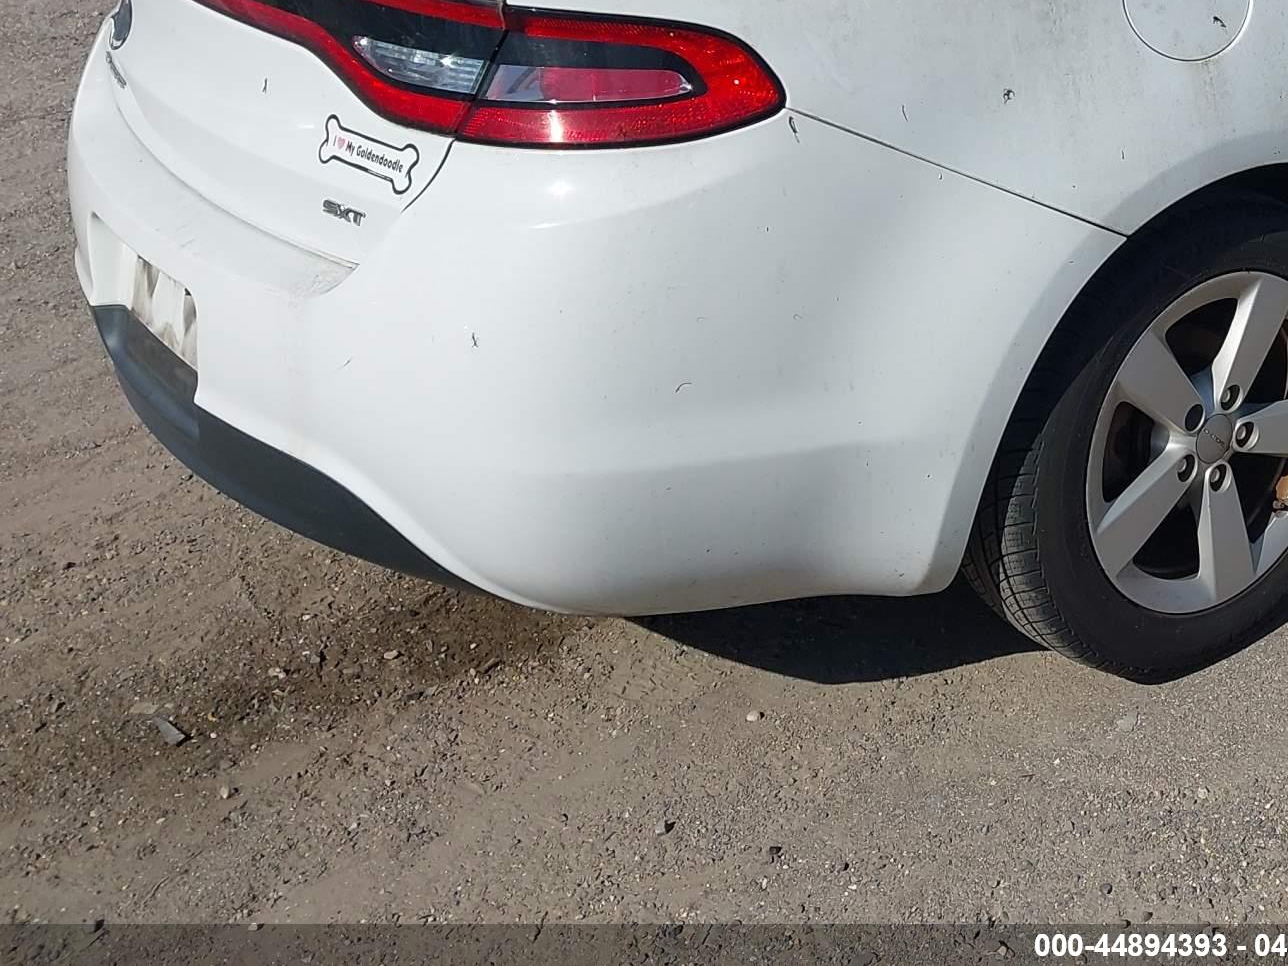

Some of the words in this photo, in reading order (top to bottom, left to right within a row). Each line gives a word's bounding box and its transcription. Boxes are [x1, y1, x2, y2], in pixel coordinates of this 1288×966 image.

[345, 140, 355, 156] My
[356, 144, 403, 173] Goldendoodle
[322, 199, 367, 227] SXT
